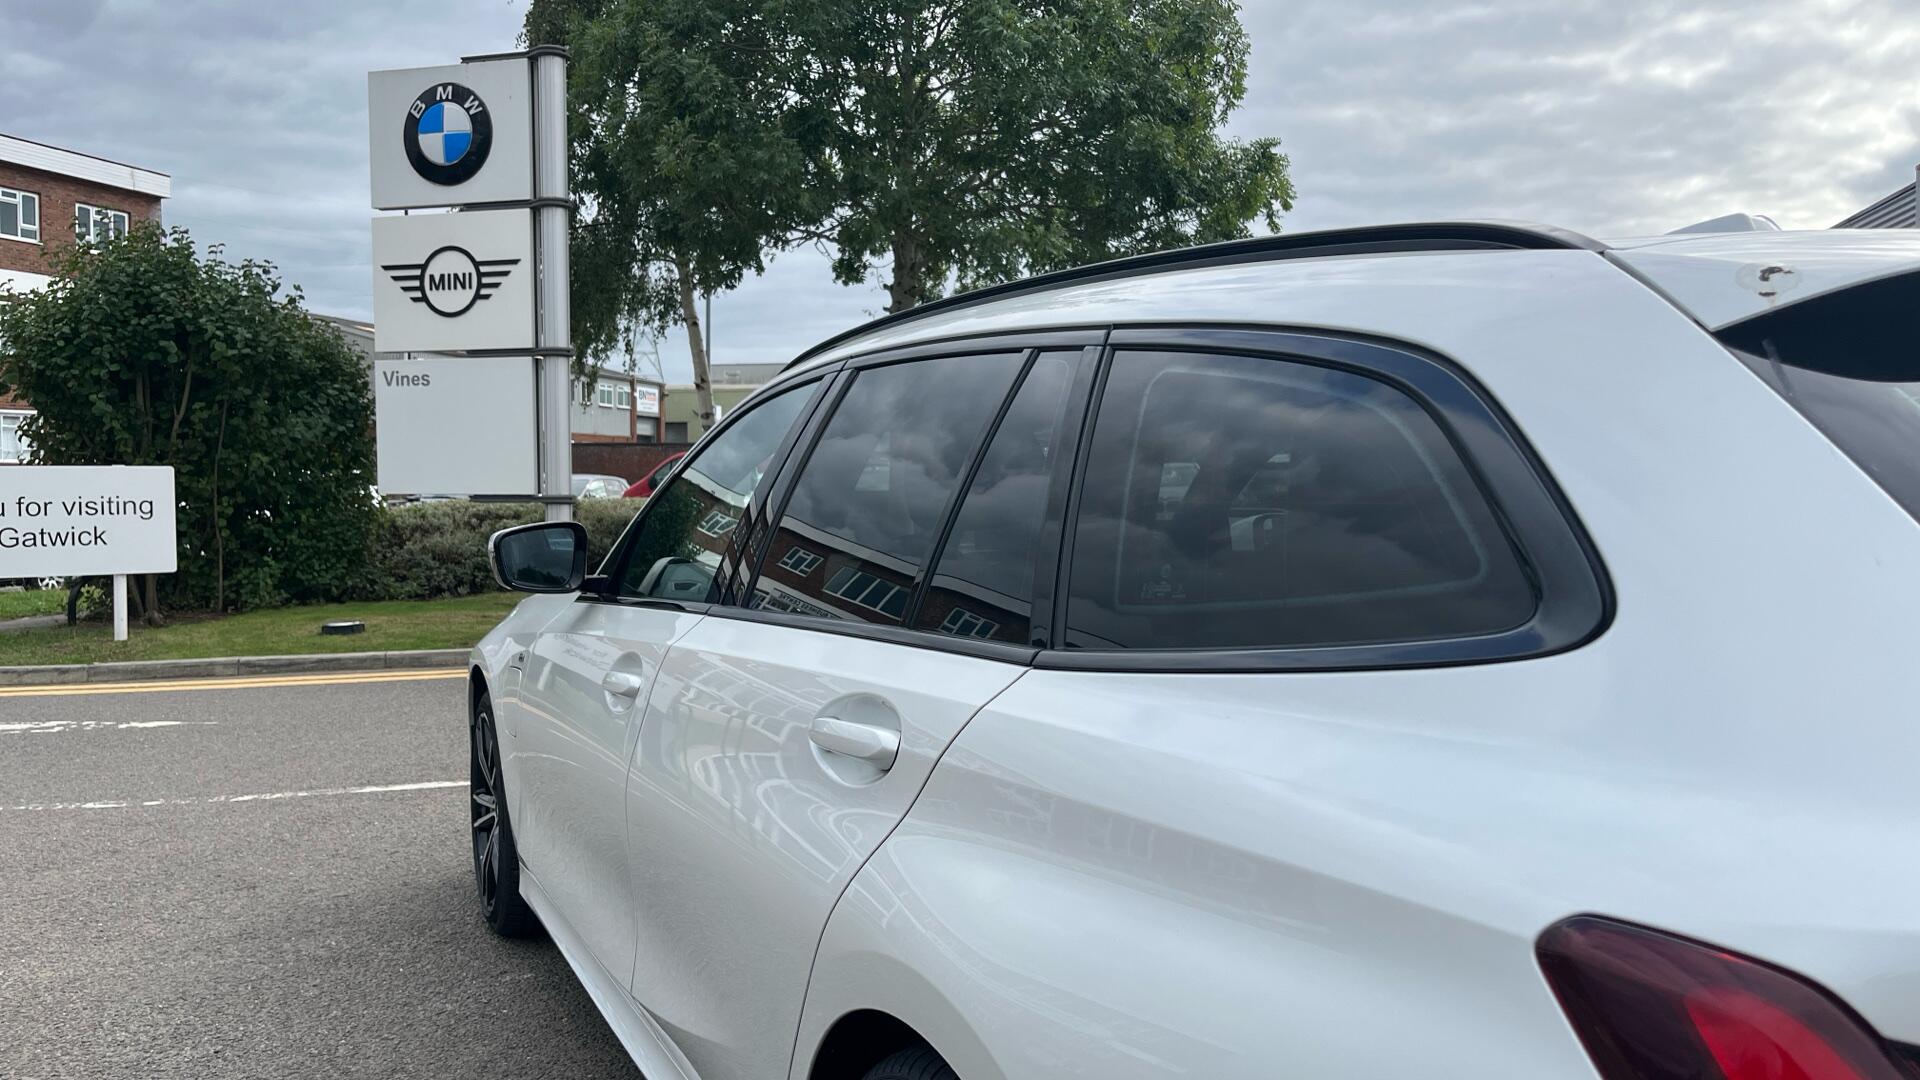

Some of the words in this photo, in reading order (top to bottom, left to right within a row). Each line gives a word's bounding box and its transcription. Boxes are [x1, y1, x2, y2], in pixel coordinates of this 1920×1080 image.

[409, 85, 483, 119] BMW
[428, 272, 473, 291] MINI
[382, 370, 431, 388] Vines
[16, 496, 52, 517] for
[62, 496, 153, 520] visiting
[0, 526, 107, 548] Gatwick
